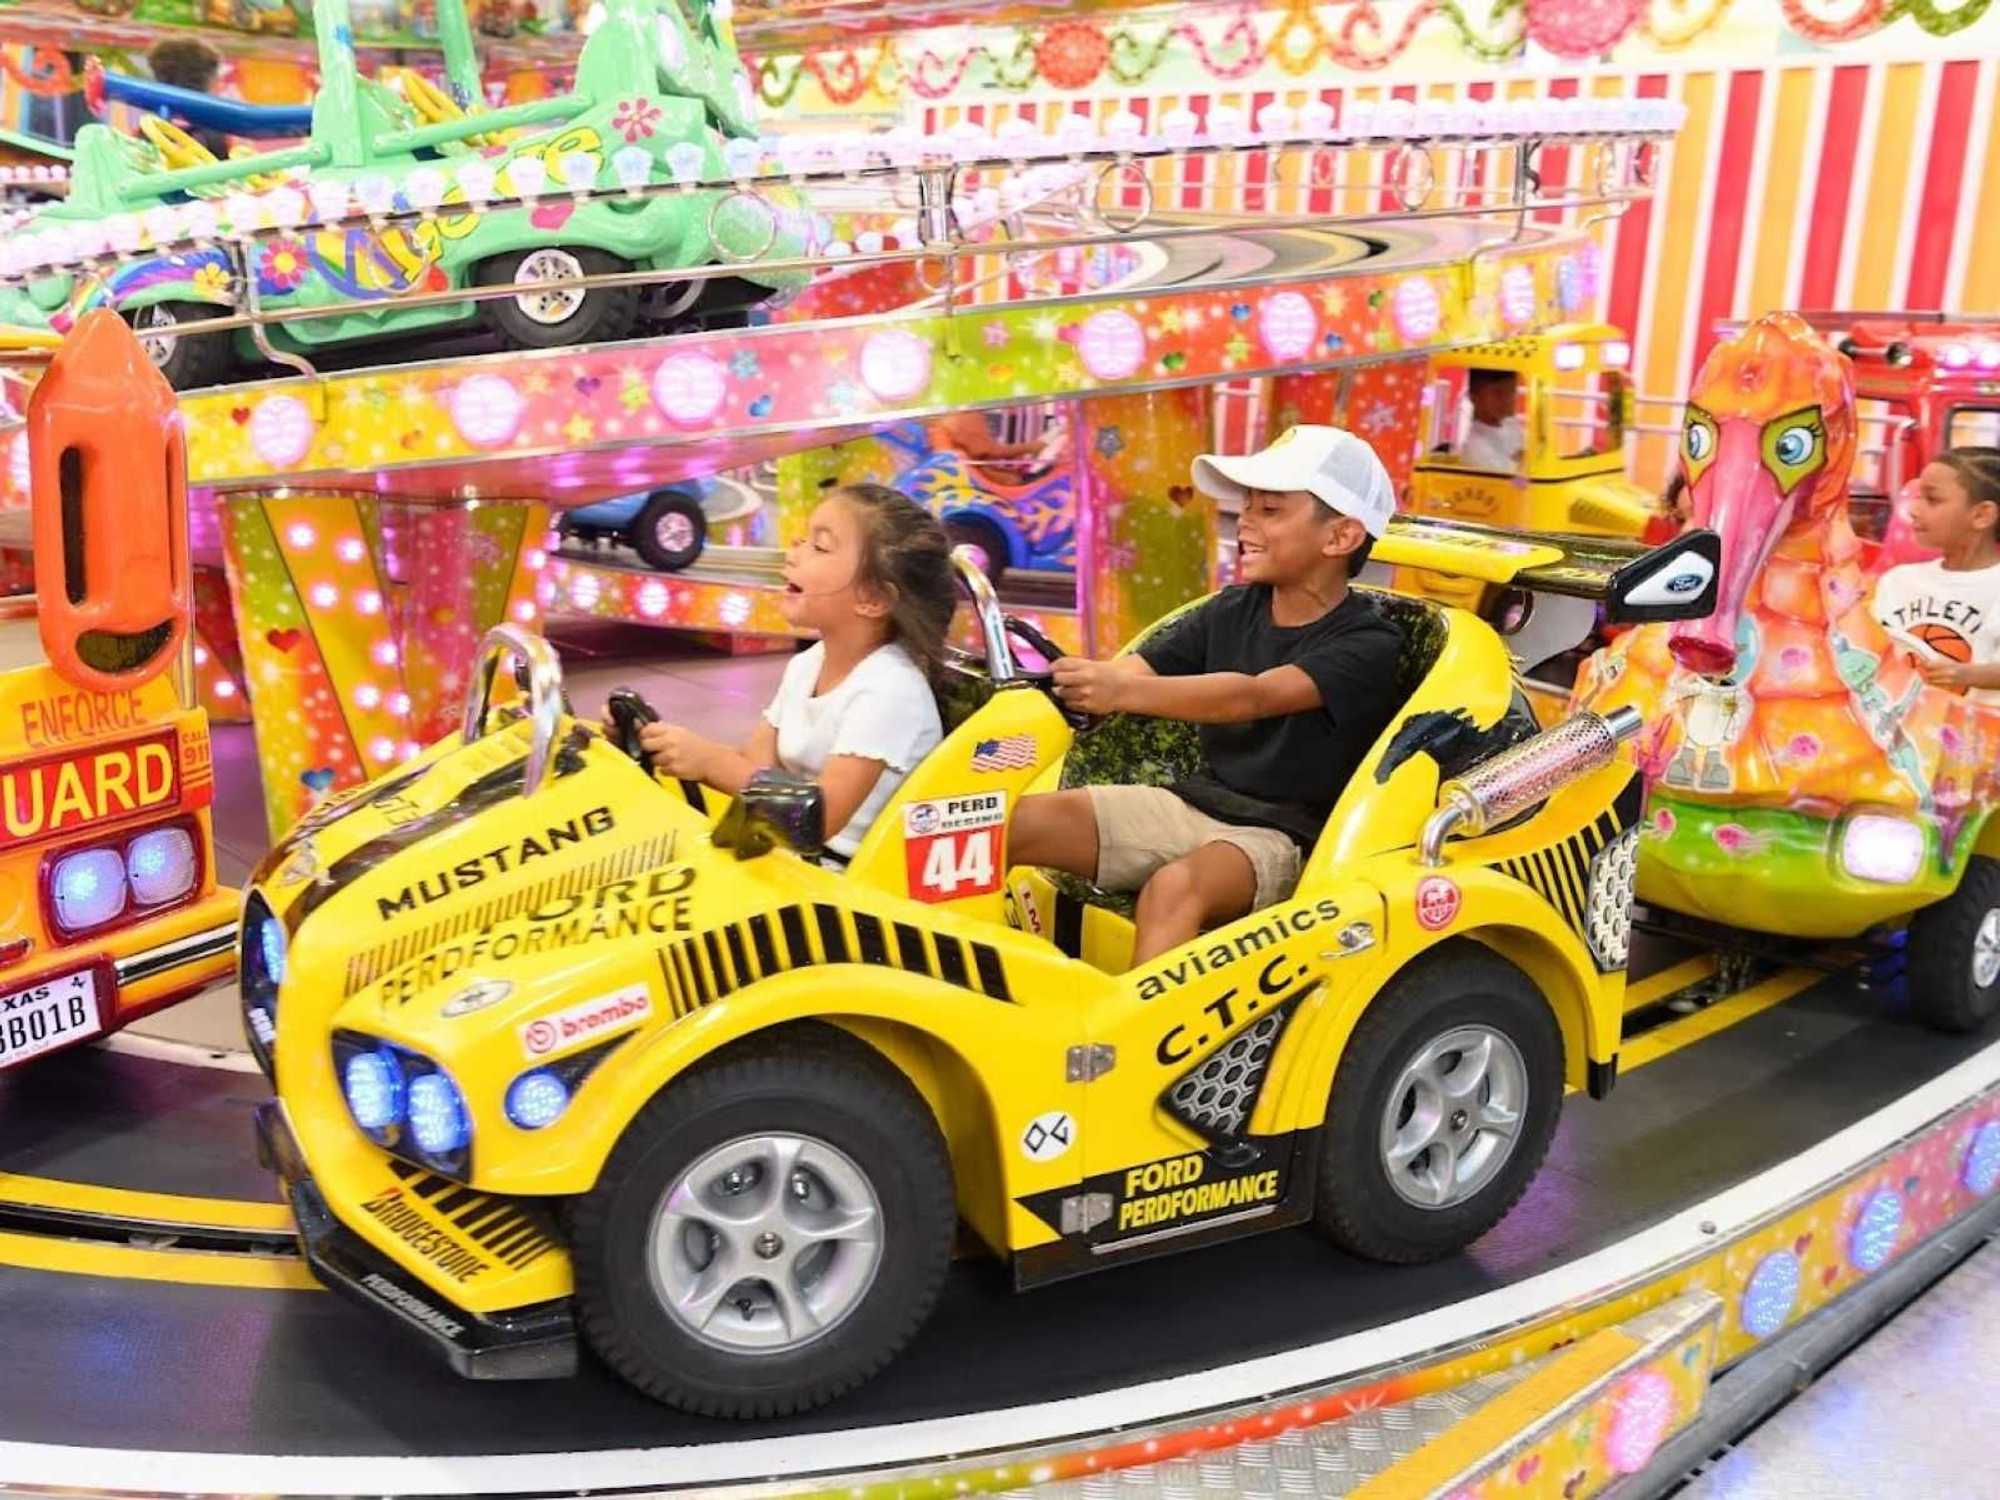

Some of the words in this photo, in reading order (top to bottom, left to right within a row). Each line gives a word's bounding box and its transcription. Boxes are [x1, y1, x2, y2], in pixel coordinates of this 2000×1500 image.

[1882, 596, 1982, 634] THLETI
[20, 689, 147, 748] ENFORCE
[3, 743, 174, 838] UARD
[948, 797, 998, 815] PERD
[377, 806, 616, 921] MUSTANG
[922, 832, 994, 893] 44
[379, 896, 692, 1008] PERDFORMANCE
[1136, 900, 1341, 1001] aviamics
[560, 996, 649, 1038] brembo
[1156, 953, 1309, 1066] C.T.C.
[1117, 1169, 1279, 1231] PERDFORMANCE
[1125, 1154, 1204, 1198] FORD
[360, 1190, 490, 1283] BRIDGESTONE
